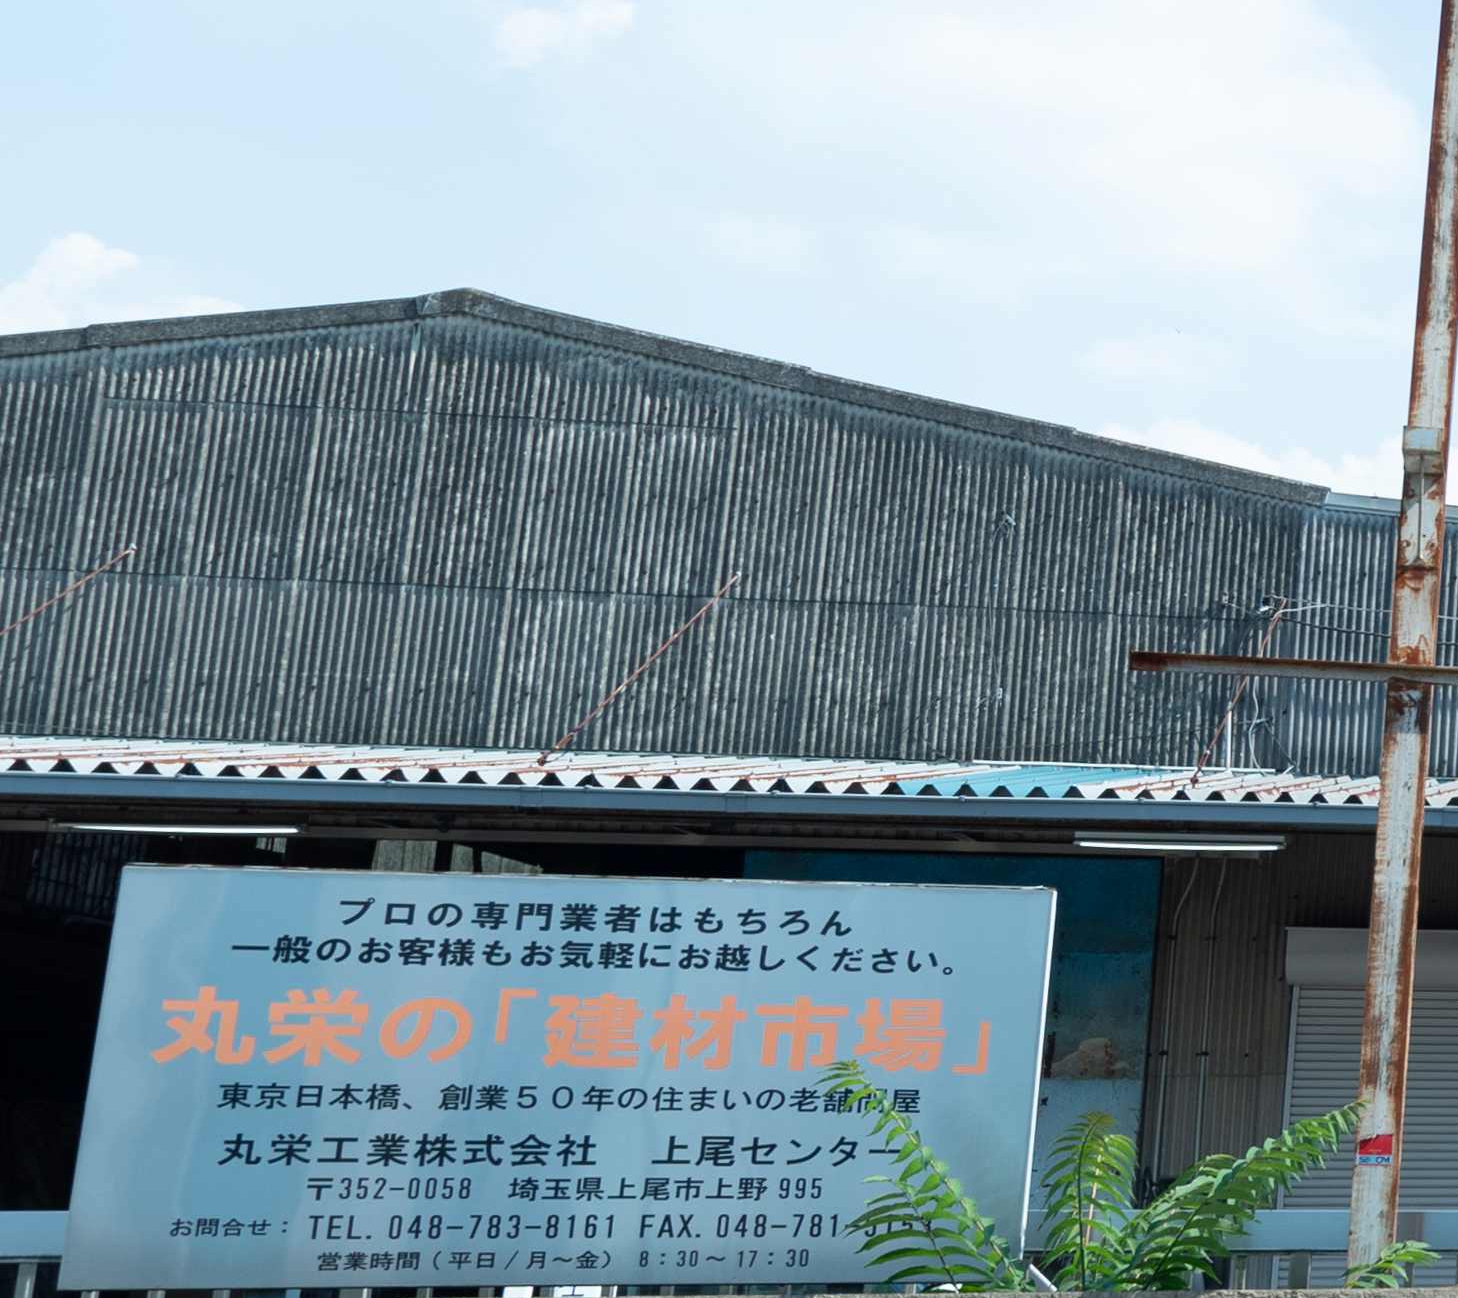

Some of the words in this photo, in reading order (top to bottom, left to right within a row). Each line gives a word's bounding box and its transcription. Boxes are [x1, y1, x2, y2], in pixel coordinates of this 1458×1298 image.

[338, 897, 853, 936] プロの専門業者はもちろん
[231, 934, 957, 977] 一般のお客様もお気軽にお越しください。
[151, 985, 991, 1075] 丸栄の「建材市場」
[216, 1133, 597, 1168] 丸栄工業株式会社
[650, 1135, 902, 1168] 上尾センター
[306, 1176, 472, 1202] 〒352-0058
[507, 1176, 769, 1203] 埼玉県上尾市上野
[778, 1177, 823, 1200] 995
[169, 1217, 289, 1238] お問合せ：
[308, 1214, 372, 1240] TEL.
[388, 1214, 614, 1240] 048-783-8161
[638, 1213, 701, 1239] FAX.
